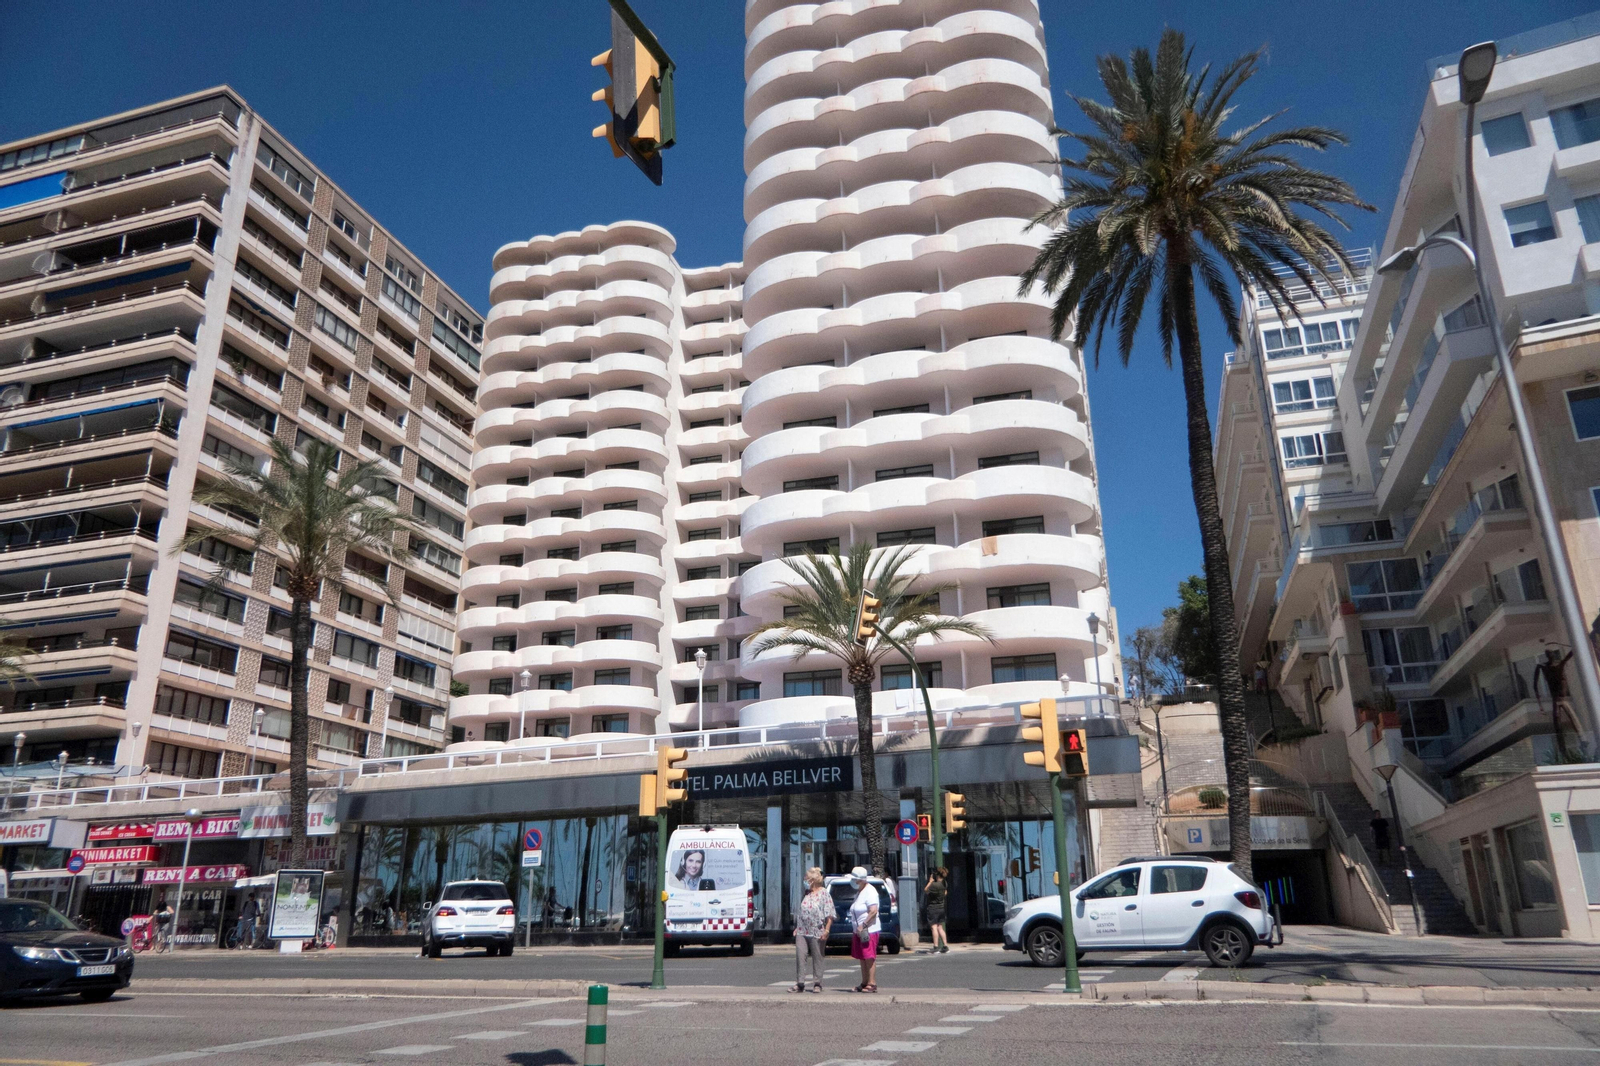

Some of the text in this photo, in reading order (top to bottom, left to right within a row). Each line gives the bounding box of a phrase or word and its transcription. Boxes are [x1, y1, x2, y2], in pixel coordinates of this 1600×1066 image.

[714, 771, 769, 790] PALMA
[772, 766, 842, 786] BELLVER
[156, 819, 240, 836] RENT A BIKE
[144, 869, 186, 881] RENT
[188, 868, 200, 880] A
[204, 866, 237, 879] CAR
[202, 889, 222, 900] CAR
